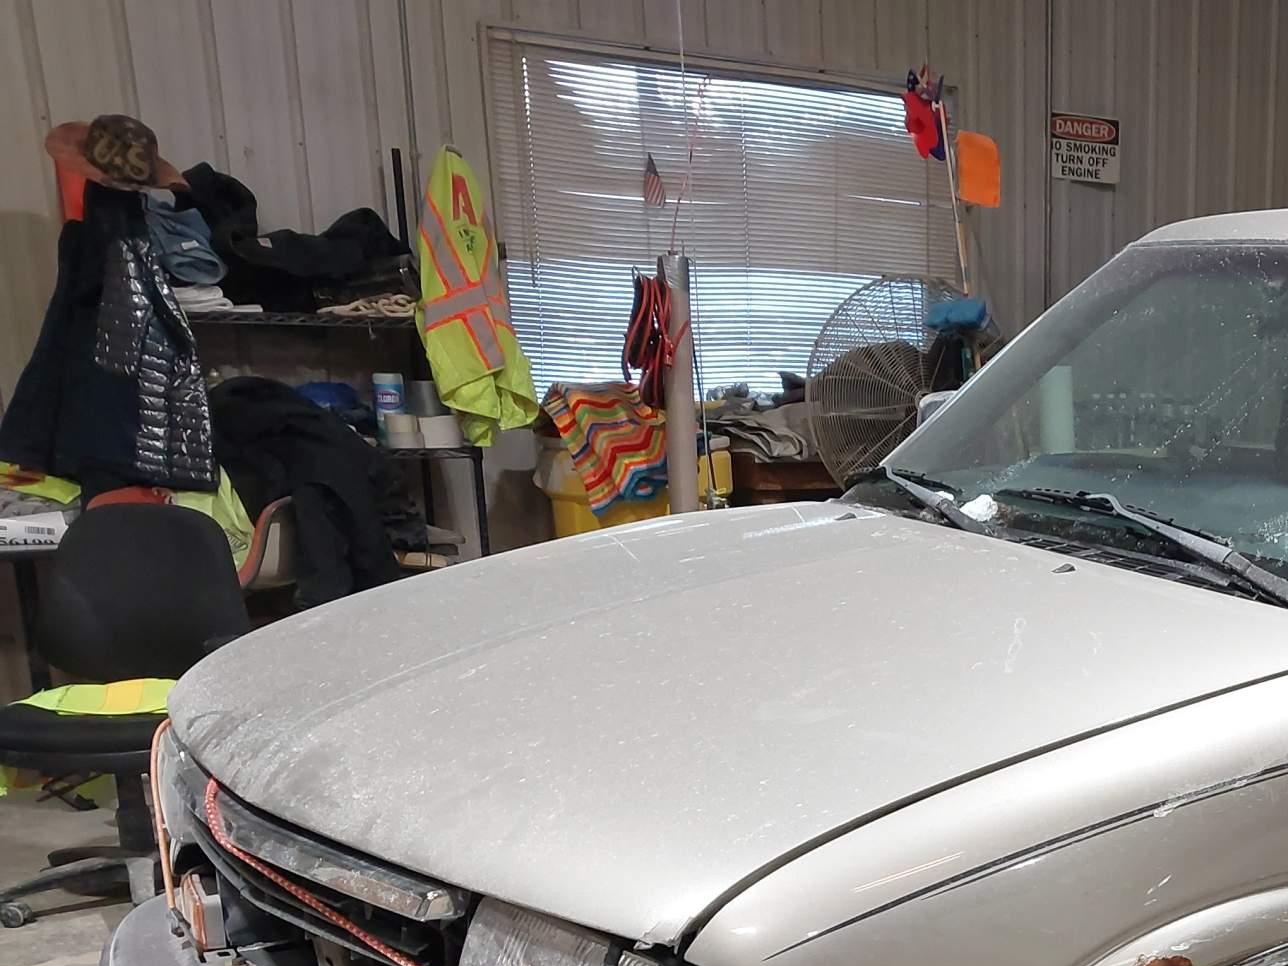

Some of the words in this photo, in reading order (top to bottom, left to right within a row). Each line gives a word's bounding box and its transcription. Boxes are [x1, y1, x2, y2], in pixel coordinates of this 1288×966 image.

[1055, 119, 1109, 138] DANGER
[1065, 141, 1117, 157] SMOKING
[1055, 152, 1084, 165] TURN
[1087, 156, 1107, 168] OFF
[1061, 165, 1102, 180] ENGINE
[451, 172, 478, 227] A
